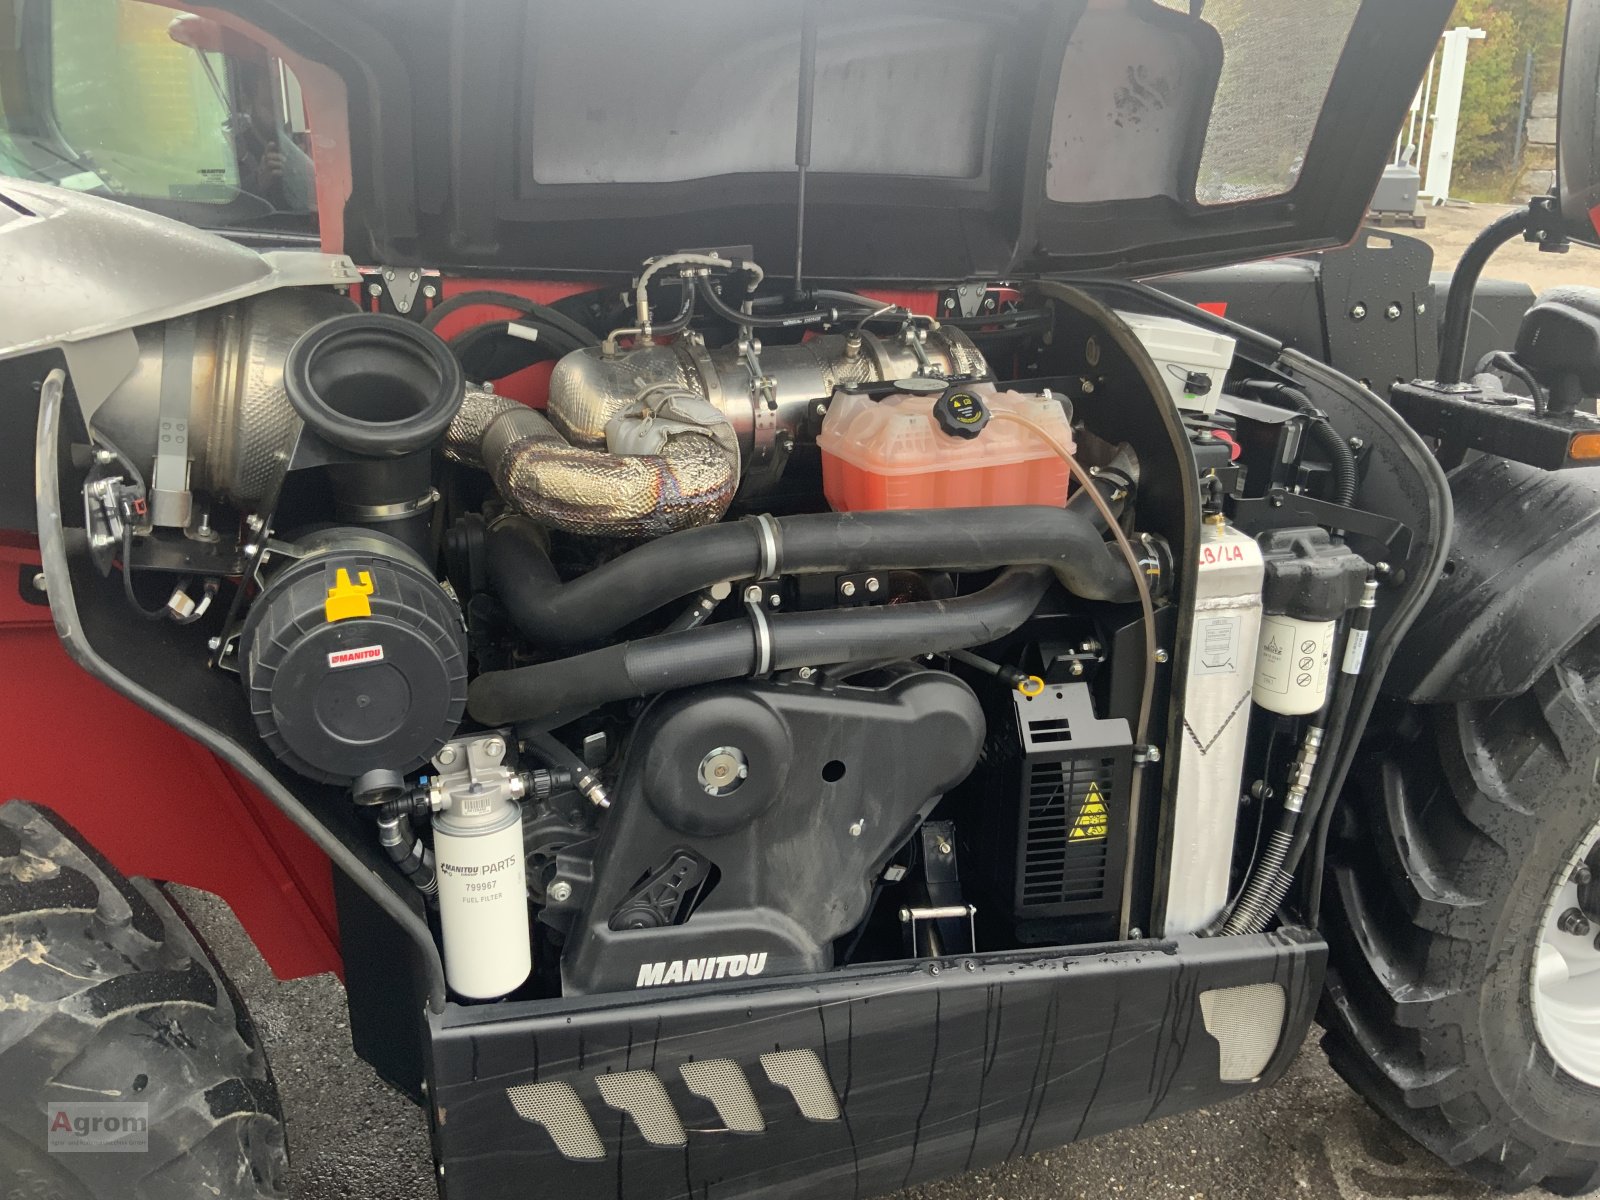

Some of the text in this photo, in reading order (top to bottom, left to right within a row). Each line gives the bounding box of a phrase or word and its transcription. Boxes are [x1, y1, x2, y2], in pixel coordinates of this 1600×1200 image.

[339, 649, 381, 663] MANITOU
[445, 854, 516, 875] MANITOU PARTS
[466, 880, 497, 892] 799967
[480, 892, 503, 902] FILTER
[636, 952, 768, 987] MANITOU
